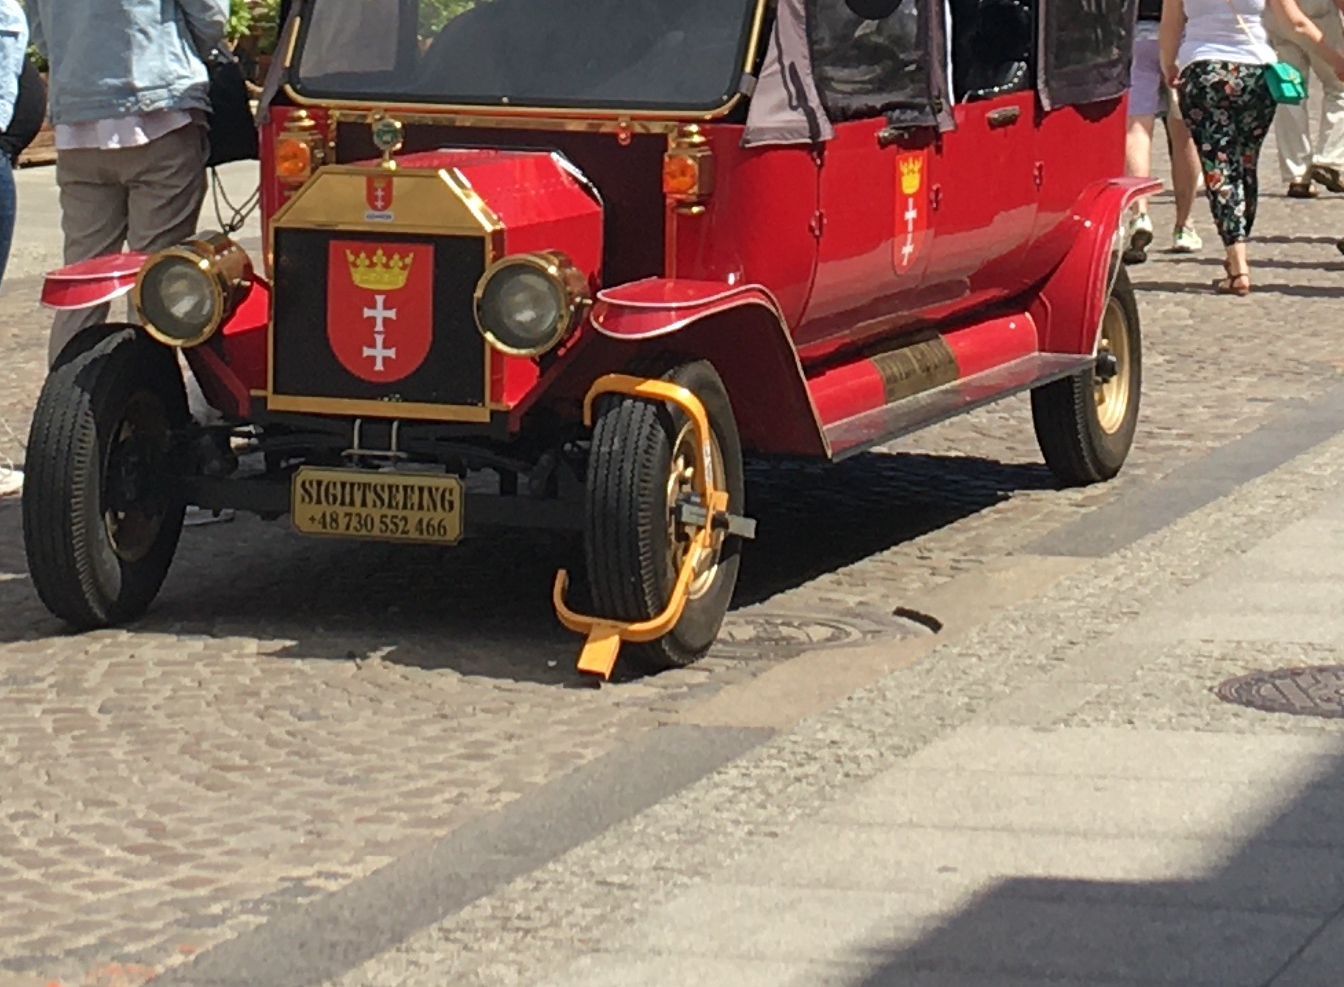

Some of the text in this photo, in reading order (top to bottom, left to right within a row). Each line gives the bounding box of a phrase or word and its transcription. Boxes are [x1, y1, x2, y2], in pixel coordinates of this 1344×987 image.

[300, 479, 455, 513] SIGHTSEEING
[309, 511, 447, 537] +48 730 552 466
